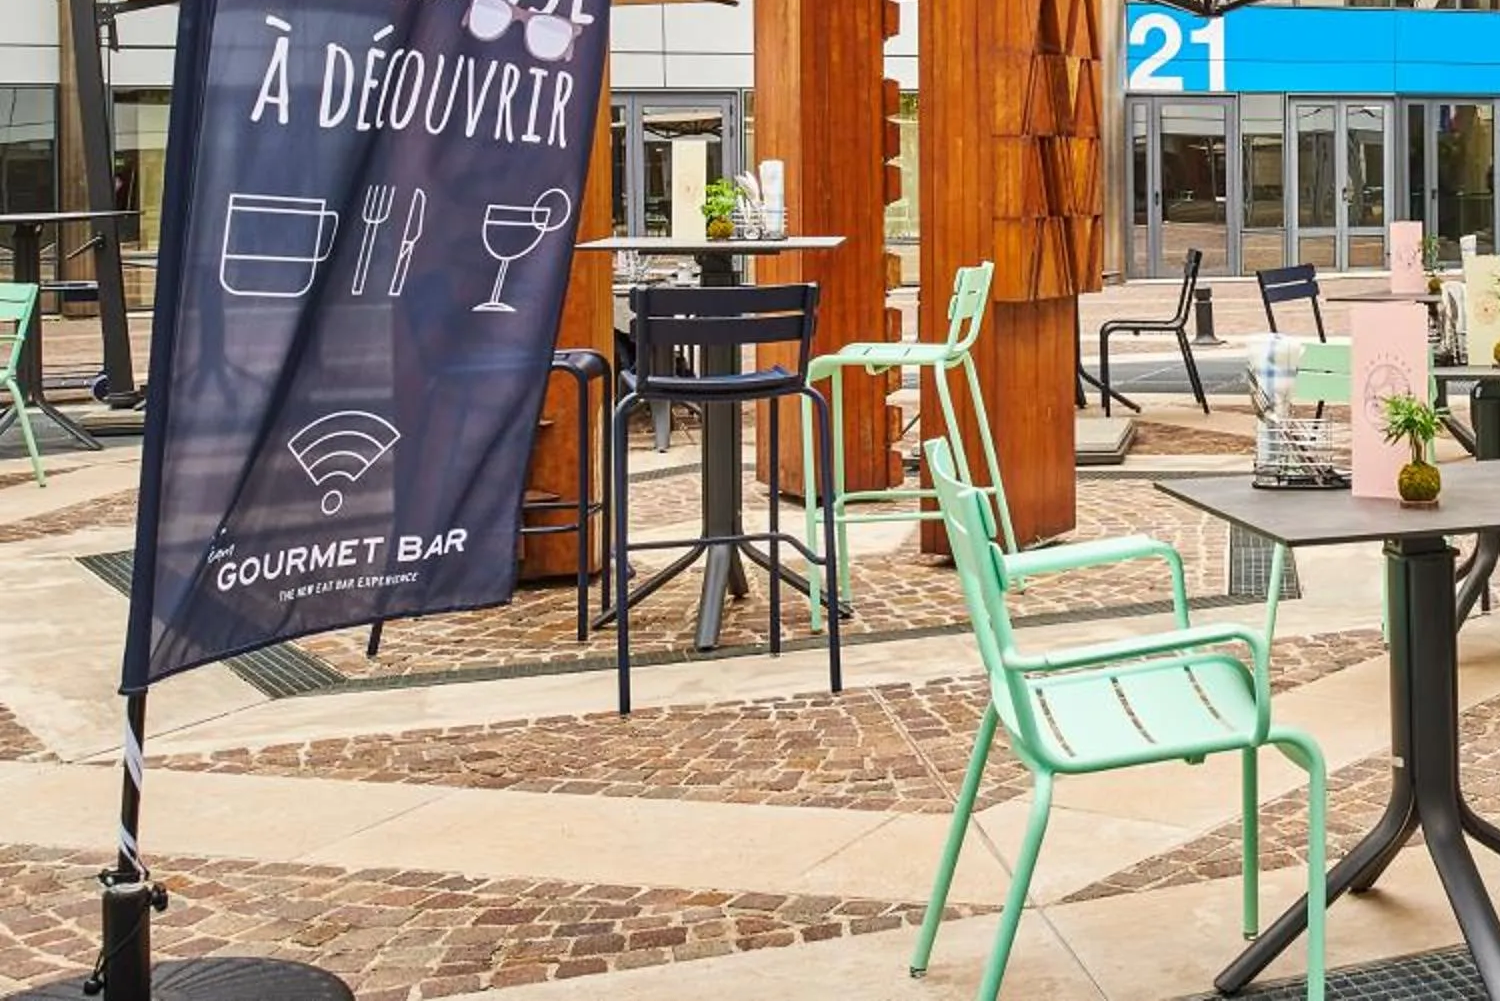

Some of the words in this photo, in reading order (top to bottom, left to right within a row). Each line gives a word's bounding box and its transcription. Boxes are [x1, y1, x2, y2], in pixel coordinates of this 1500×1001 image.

[250, 13, 292, 124] À
[318, 23, 574, 149] DÉCOUVRIR
[1129, 12, 1225, 91] 21
[216, 536, 385, 591] GOURMET
[396, 528, 469, 562] BAR
